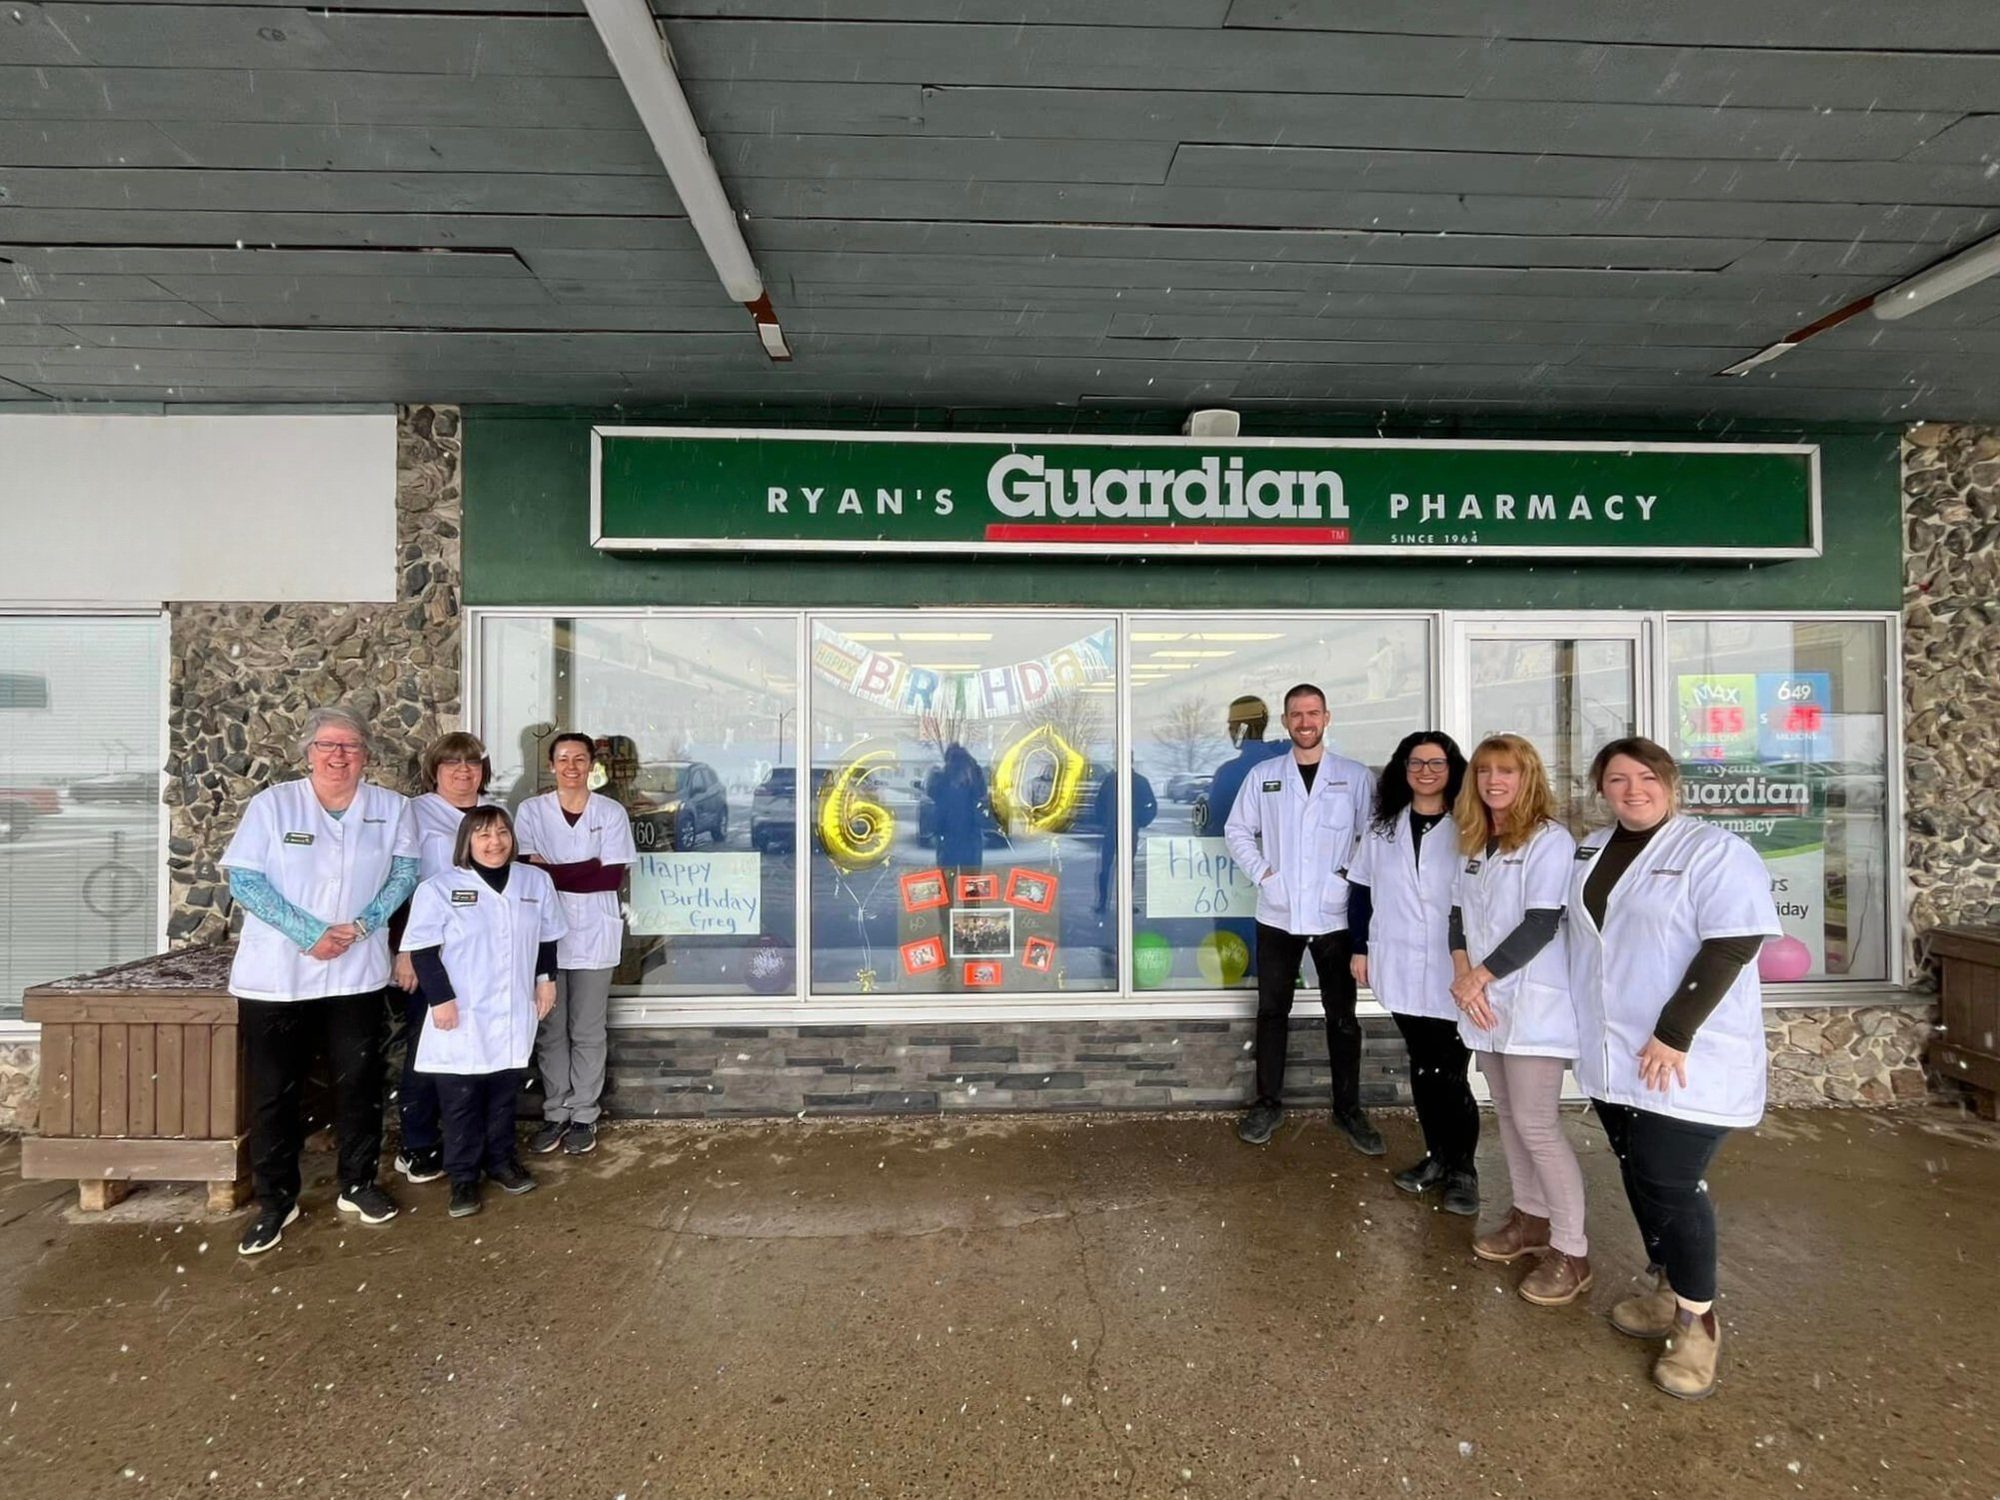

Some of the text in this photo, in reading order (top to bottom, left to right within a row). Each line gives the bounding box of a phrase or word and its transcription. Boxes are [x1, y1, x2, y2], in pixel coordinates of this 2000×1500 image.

[986, 453, 1349, 519] Guardian
[767, 487, 954, 514] RYAN'S
[1389, 492, 1658, 520] PHARMACY
[1391, 533, 1478, 543] SINCE 1964
[1692, 683, 1740, 706] MAX
[1685, 777, 1809, 805] uardian
[640, 854, 711, 886] Happy
[1168, 839, 1253, 888] Happ
[660, 887, 757, 922] Birthday
[1194, 886, 1229, 913] 60
[689, 909, 736, 934] Greg
